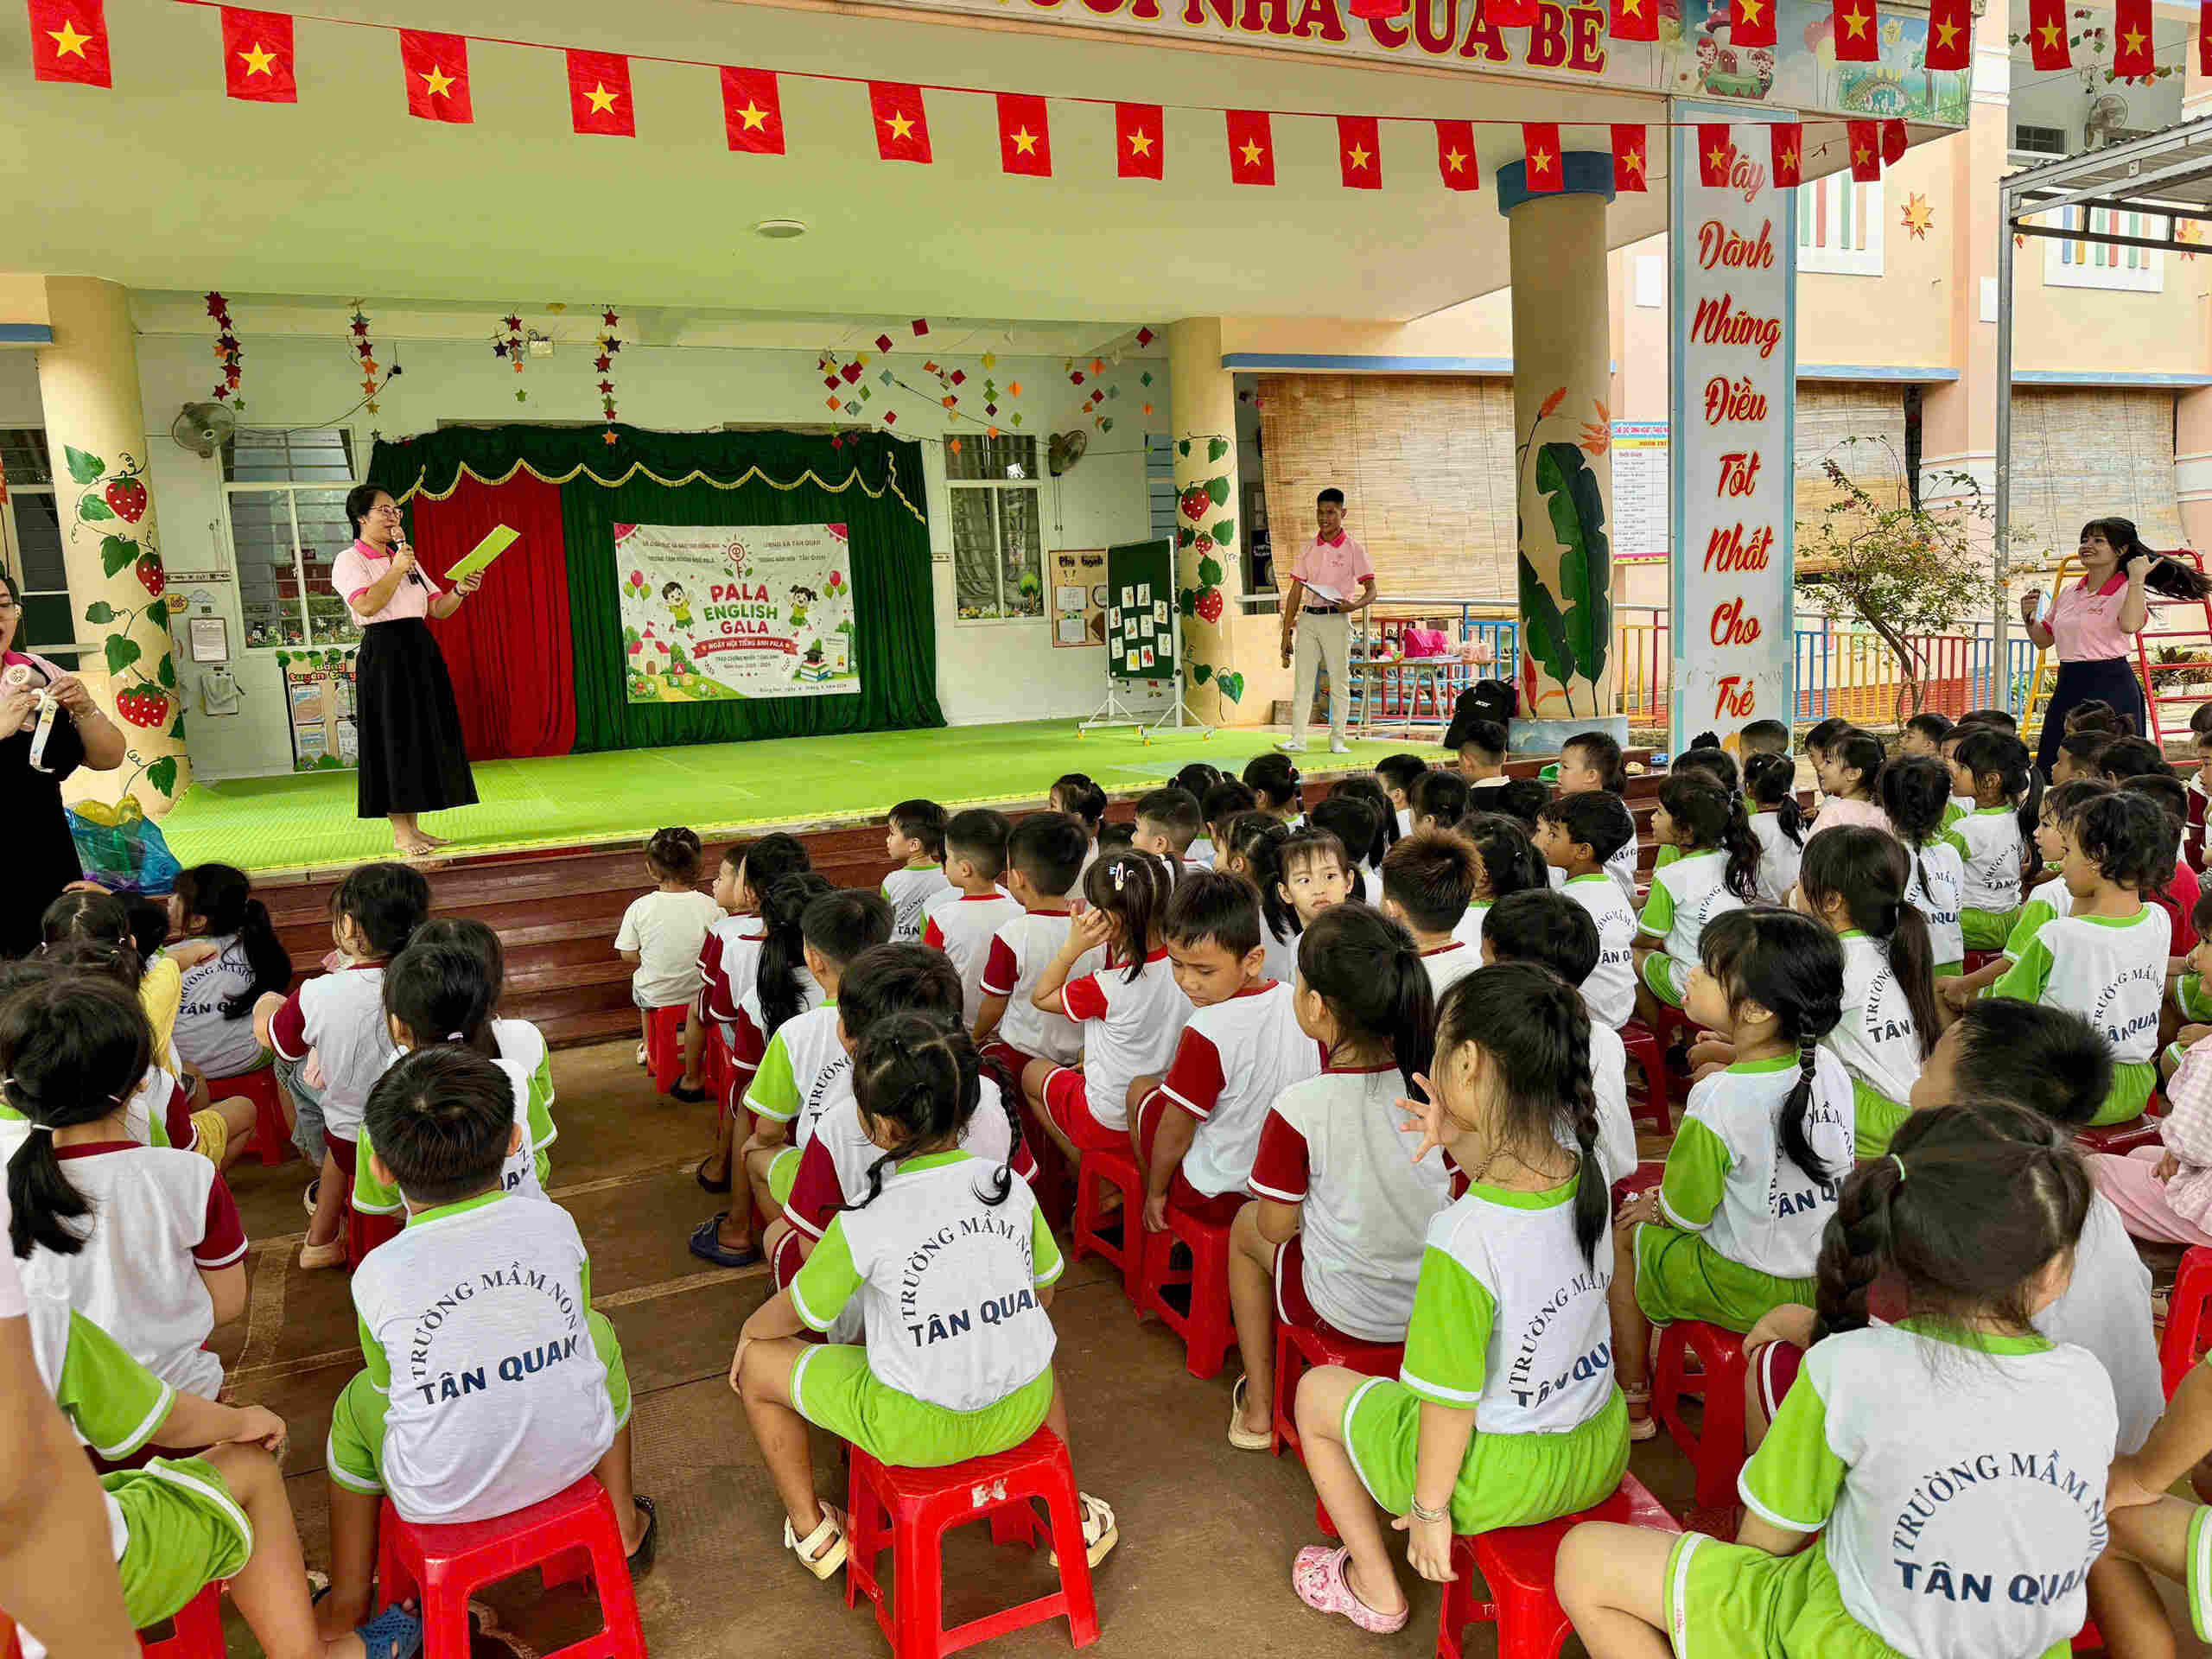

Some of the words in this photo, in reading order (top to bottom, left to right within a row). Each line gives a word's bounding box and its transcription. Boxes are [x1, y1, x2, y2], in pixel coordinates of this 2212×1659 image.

[1698, 218, 1775, 270] Dành
[1690, 292, 1783, 359] Những
[1704, 375, 1768, 426] Điều
[1704, 521, 1774, 573] Nhất
[703, 604, 779, 622] ENGLISH
[710, 582, 770, 603] PALA
[720, 620, 769, 635] GALA
[1710, 596, 1763, 646] Cho
[1714, 675, 1755, 720] Trẻ
[1602, 949, 1619, 964] ÂN
[1866, 966, 1894, 1026] TRƯỜNG
[1868, 1019, 1911, 1043] TÂN
[2128, 1011, 2158, 1034] QUA
[900, 1226, 955, 1321] TRƯỜNG
[959, 1210, 1015, 1240] MẦM
[410, 1282, 475, 1381] TRƯỜNG
[480, 1261, 547, 1290] MẦM
[547, 1282, 579, 1331] NON
[907, 1309, 971, 1348] TÂN
[1508, 1287, 1569, 1386] TRƯỜNG
[416, 1367, 487, 1406] TÂN
[1892, 1453, 2000, 1552] TRƯỜNG
[2009, 1449, 2088, 1502] MẦM
[1893, 1557, 1993, 1604] TÂN
